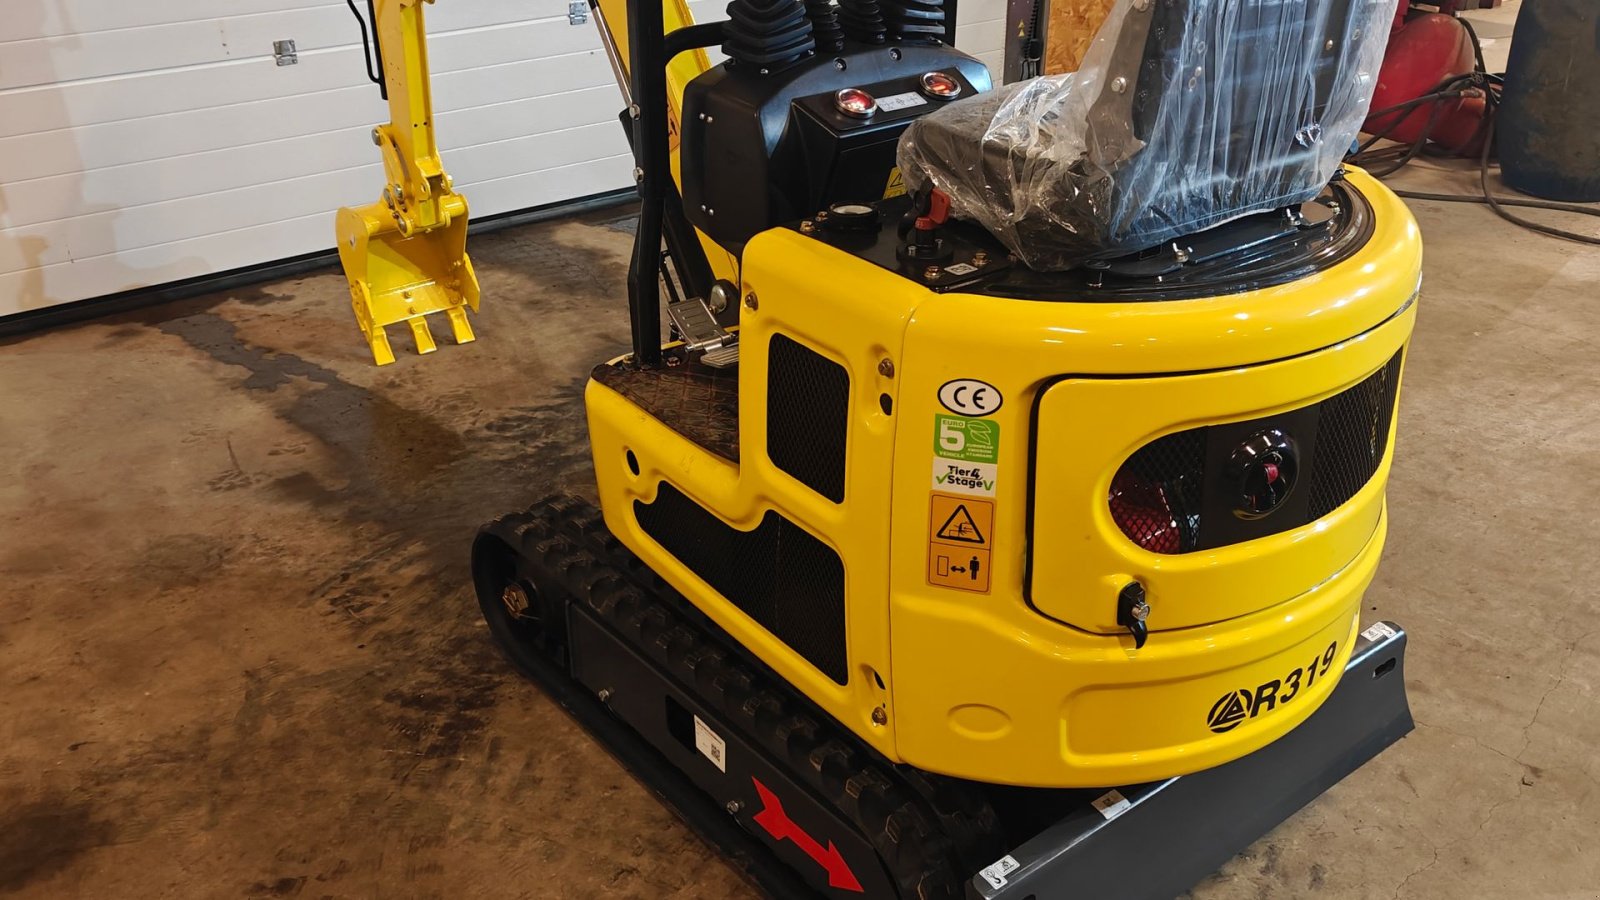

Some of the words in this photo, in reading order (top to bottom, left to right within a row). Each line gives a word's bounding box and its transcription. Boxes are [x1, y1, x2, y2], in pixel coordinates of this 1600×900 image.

[953, 386, 986, 410] CE
[940, 418, 965, 452] 5
[942, 419, 964, 427] EURO
[939, 450, 965, 459] VEHICLE
[1249, 641, 1337, 719] R319
